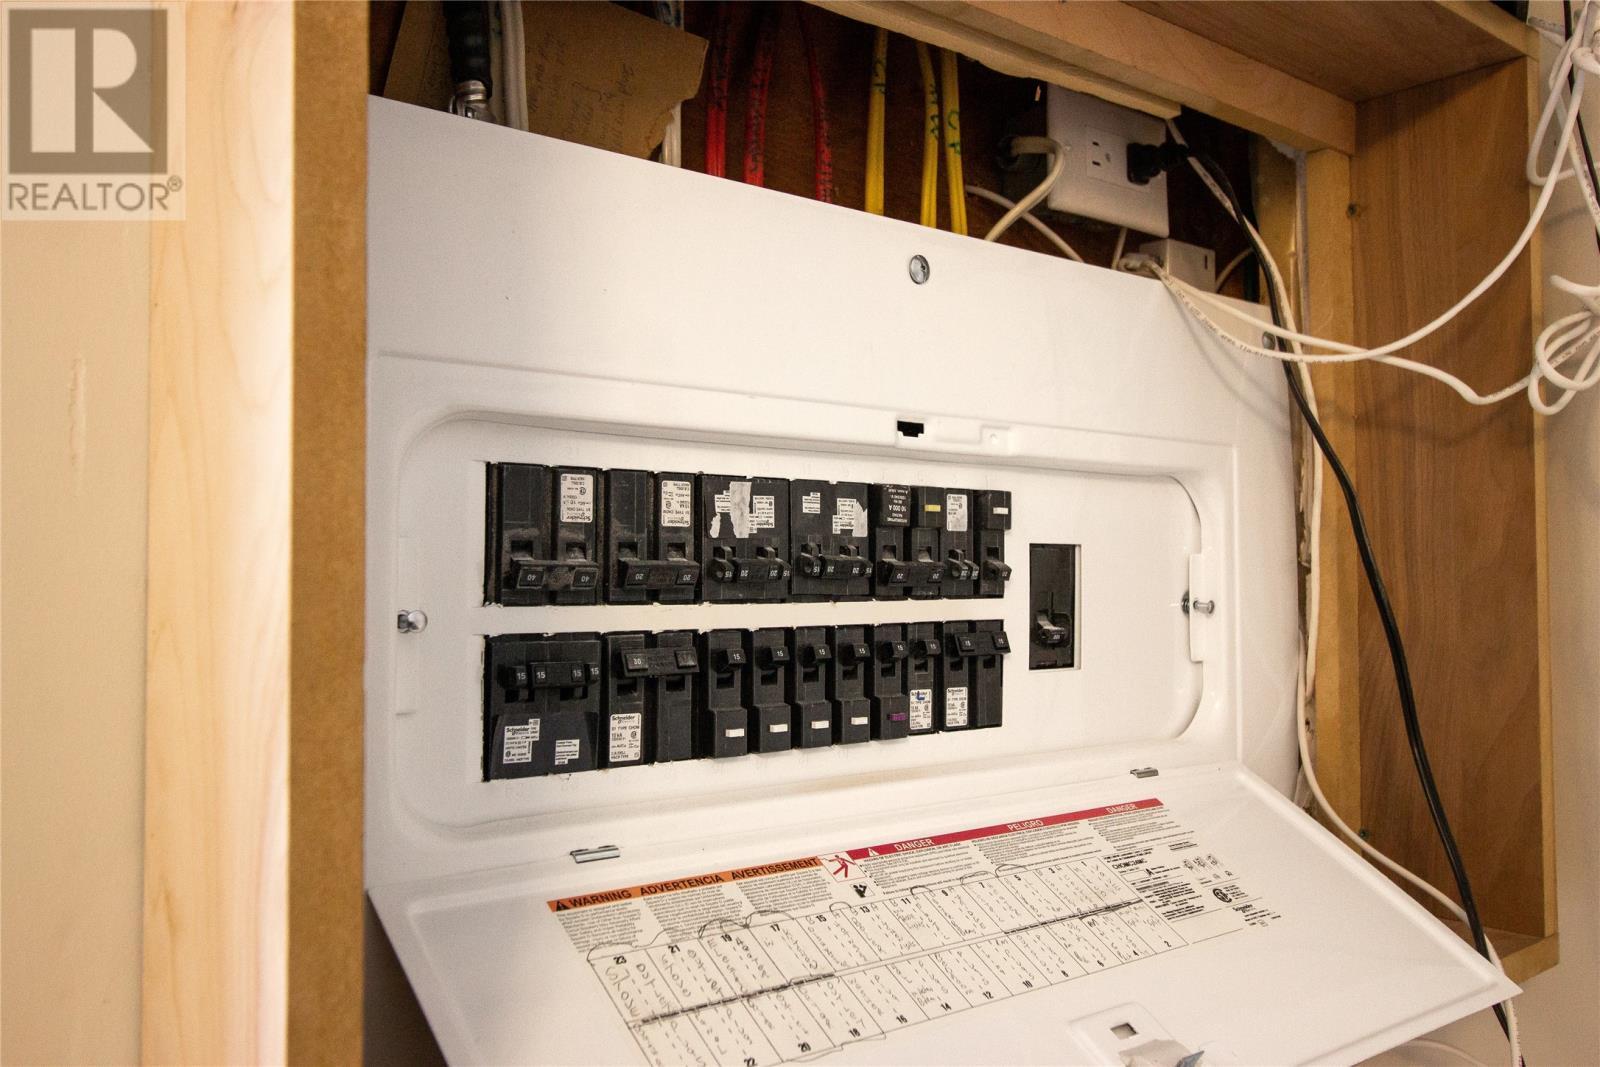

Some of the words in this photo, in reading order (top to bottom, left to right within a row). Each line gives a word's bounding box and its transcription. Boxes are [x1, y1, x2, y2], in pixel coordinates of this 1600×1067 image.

[536, 671, 546, 679] 15
[572, 669, 582, 677] 15
[591, 667, 599, 675] 15
[517, 672, 526, 680] 15
[1105, 802, 1138, 815] DANGER
[1007, 818, 1045, 832] PELIGRO
[894, 838, 936, 852] DANGER
[568, 889, 633, 909] WARNING
[639, 873, 726, 897] ADVERTENCIA
[731, 857, 819, 881] AVERTISSEMENT
[900, 897, 911, 905] 11
[859, 905, 870, 914] 13
[815, 914, 827, 923] 15
[770, 923, 781, 932] 17
[720, 934, 733, 943] 19
[668, 945, 681, 954] 21
[613, 956, 627, 965] 23
[982, 991, 994, 1000] 12
[940, 1002, 952, 1012] 14
[896, 1015, 908, 1025] 16
